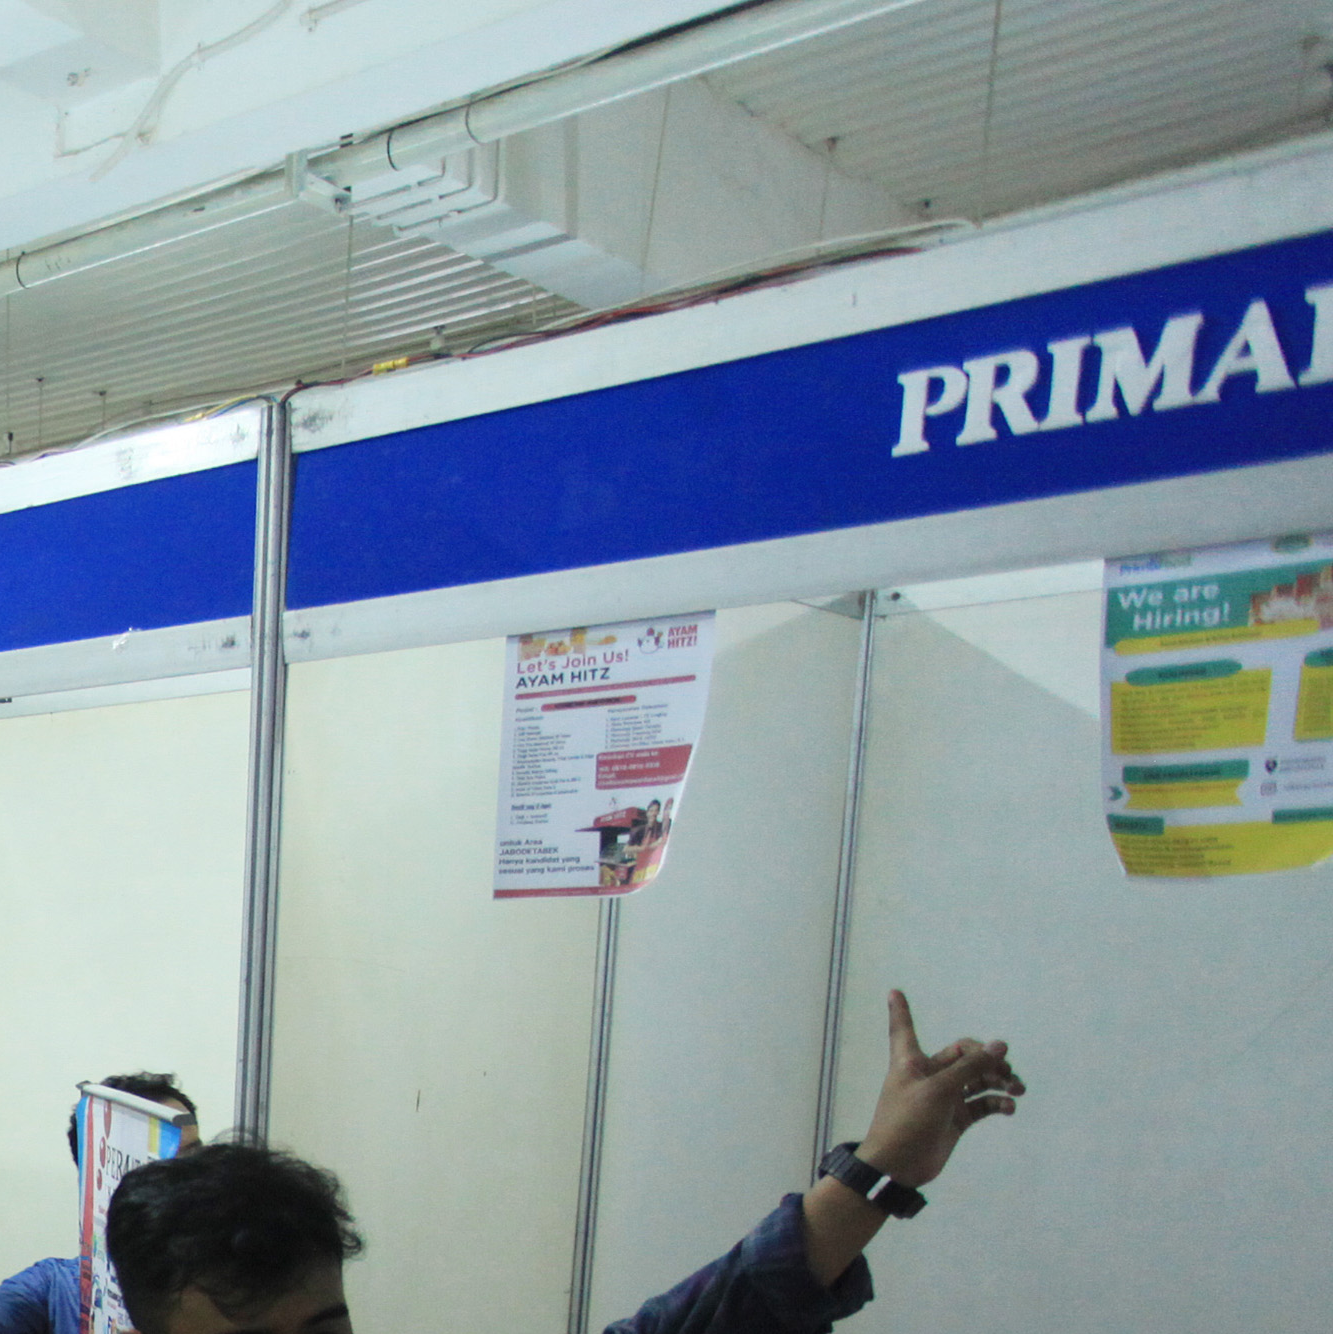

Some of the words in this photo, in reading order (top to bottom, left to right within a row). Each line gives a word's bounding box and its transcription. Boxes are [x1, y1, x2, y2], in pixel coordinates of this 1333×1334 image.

[1117, 586, 1164, 611] We
[1173, 582, 1221, 603] are
[1133, 602, 1231, 631] Hiring!
[667, 635, 698, 650] HITZ!
[668, 624, 698, 638] AYAM
[516, 658, 557, 675] Let's
[562, 654, 598, 671] Join
[603, 648, 630, 664] Us!
[515, 672, 565, 690] AYAM
[570, 667, 611, 684] HITZ
